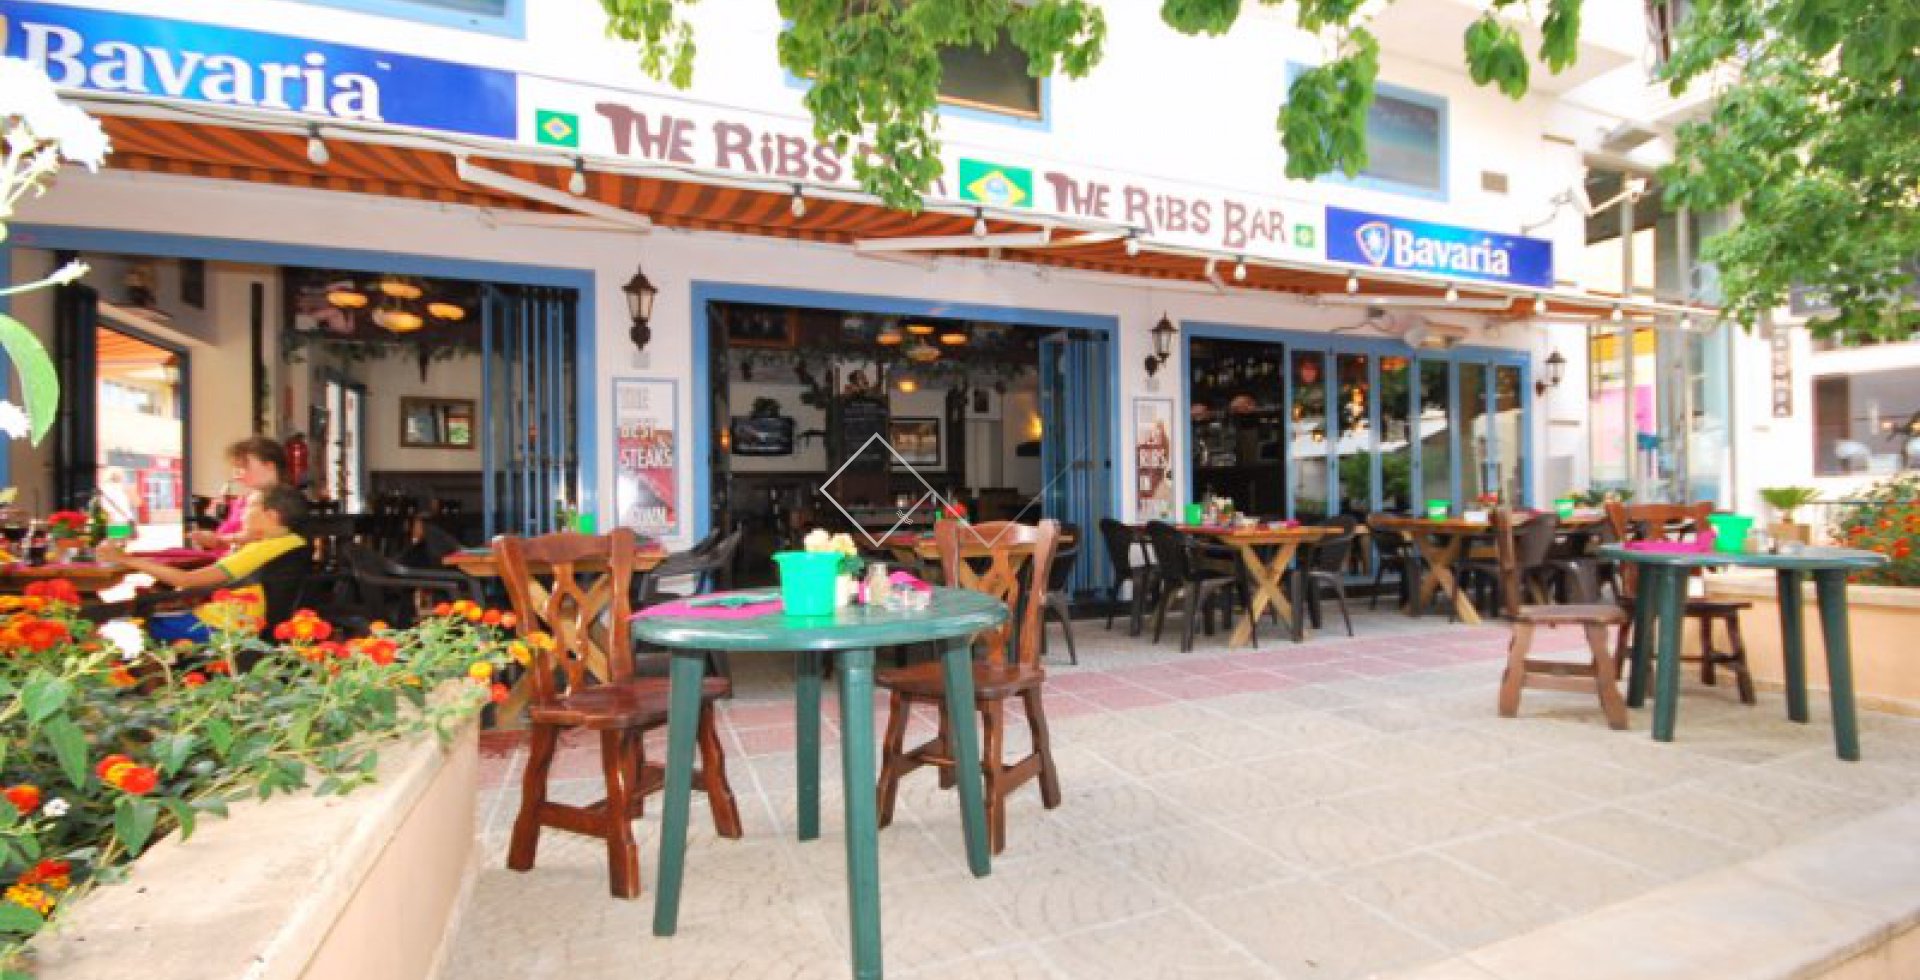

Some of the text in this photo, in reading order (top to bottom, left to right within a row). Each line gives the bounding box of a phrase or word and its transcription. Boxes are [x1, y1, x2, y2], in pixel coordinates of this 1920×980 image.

[20, 22, 384, 123] Bavaria
[595, 102, 695, 164] THE
[1044, 171, 1110, 218] THE
[1222, 200, 1286, 249] BAR
[1393, 228, 1510, 276] Bavaria
[620, 448, 673, 469] STEAKS
